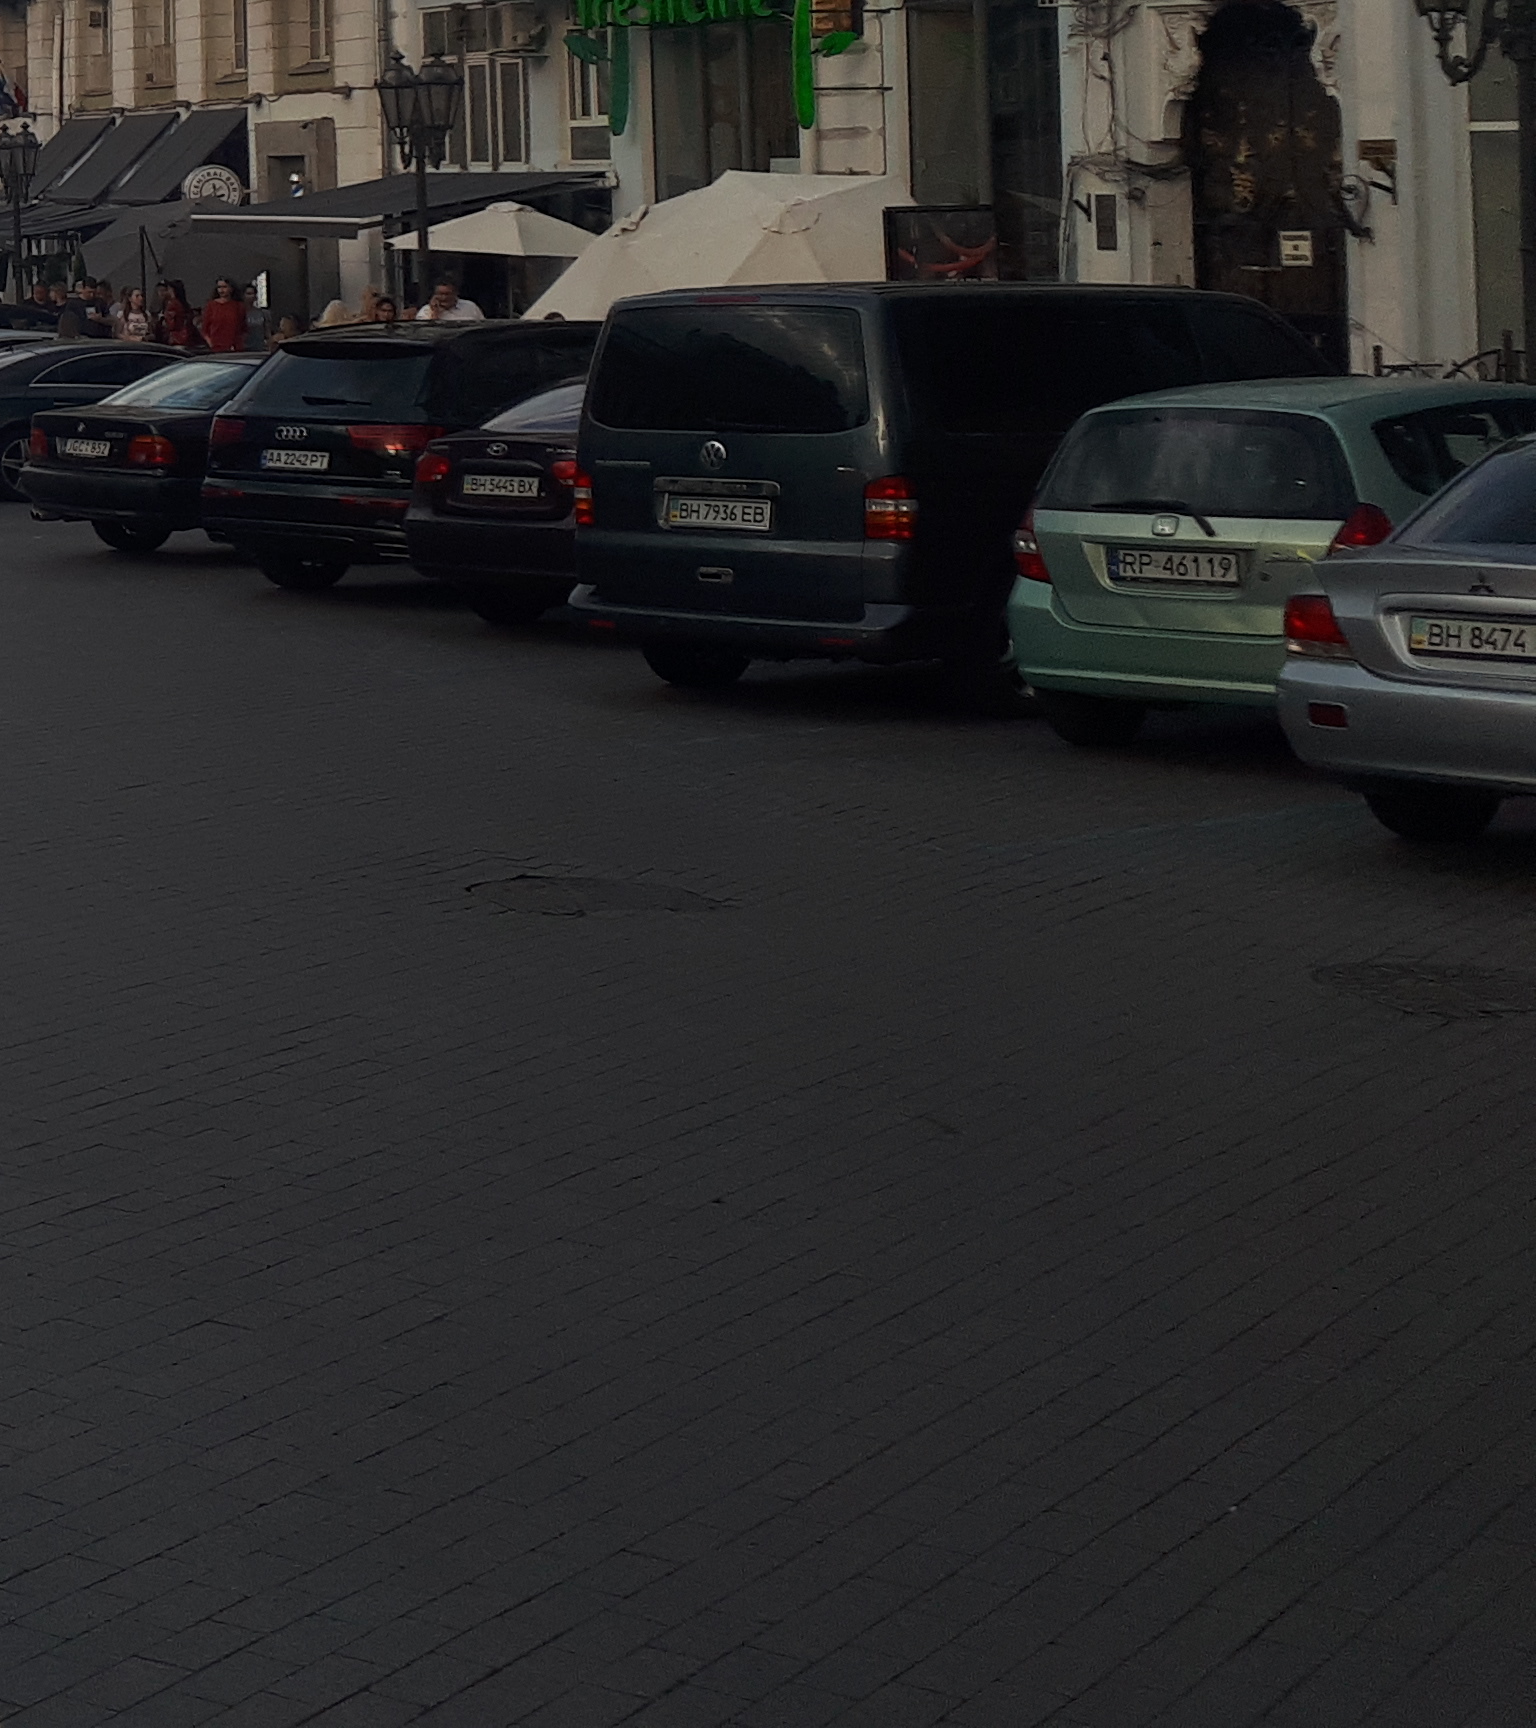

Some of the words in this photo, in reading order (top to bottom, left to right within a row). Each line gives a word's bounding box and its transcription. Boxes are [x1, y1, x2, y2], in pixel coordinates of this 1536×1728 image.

[192, 171, 223, 195] CENTRAL
[225, 176, 238, 193] BAR
[268, 452, 282, 465] AA
[470, 477, 487, 492] BH
[517, 479, 535, 494] BX
[679, 502, 701, 520] BH
[703, 503, 738, 522] 7936
[741, 505, 765, 523] EB
[1428, 623, 1462, 648] BH
[1469, 626, 1527, 653] 8474
